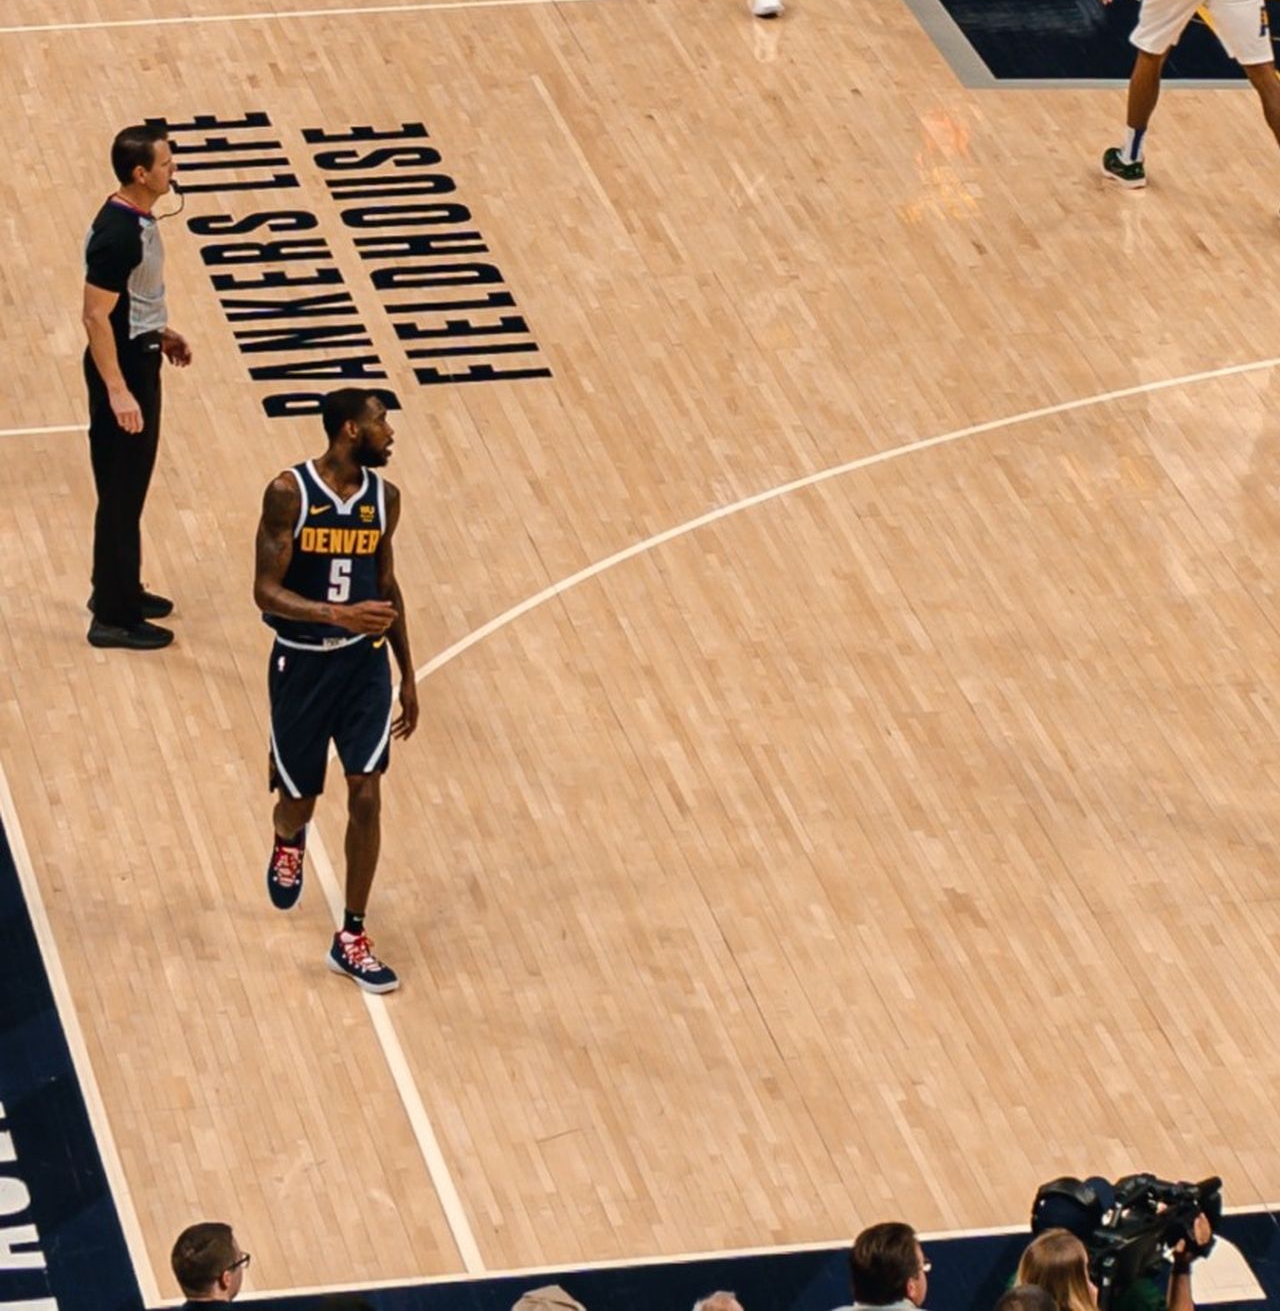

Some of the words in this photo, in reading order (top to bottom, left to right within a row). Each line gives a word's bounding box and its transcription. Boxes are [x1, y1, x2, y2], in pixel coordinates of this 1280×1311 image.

[144, 111, 301, 194] LIFE
[301, 122, 553, 385] FIELDHOUSE
[187, 210, 402, 419] BANKERS
[300, 527, 381, 554] DENVER
[327, 559, 352, 603] 5
